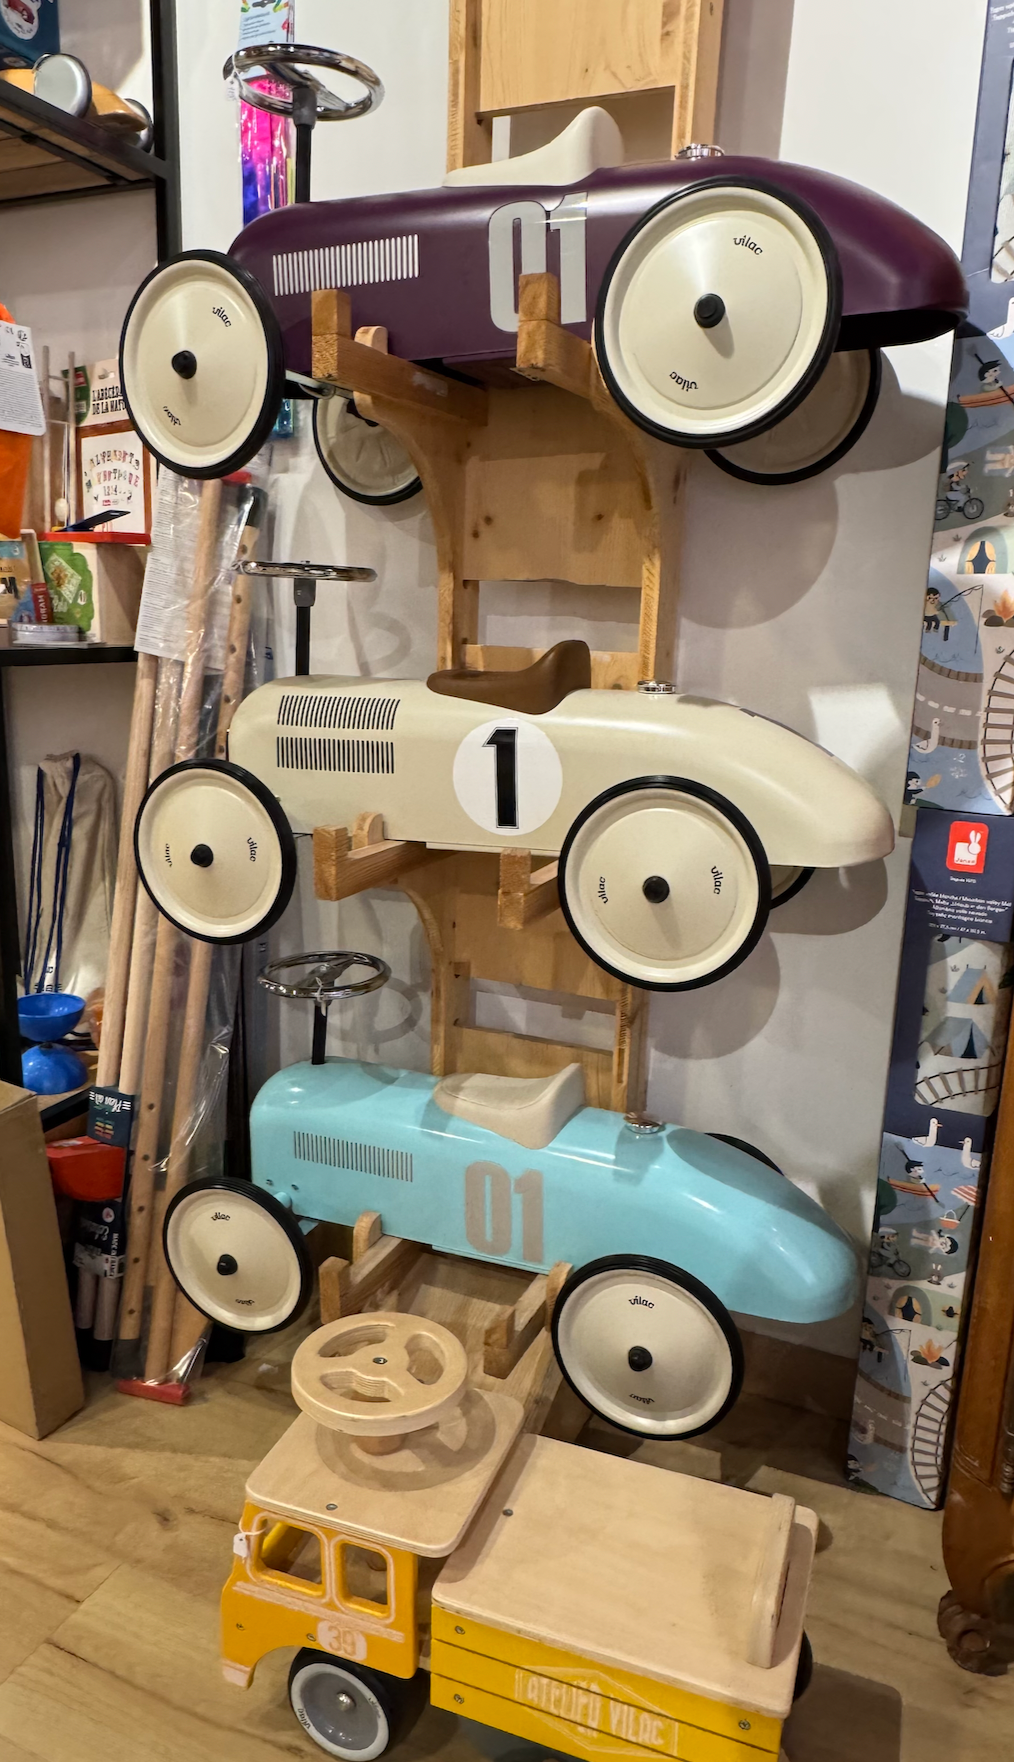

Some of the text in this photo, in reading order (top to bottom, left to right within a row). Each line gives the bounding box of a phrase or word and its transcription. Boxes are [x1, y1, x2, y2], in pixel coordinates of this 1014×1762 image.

[732, 233, 763, 256] vilac
[488, 191, 588, 332] 01
[211, 306, 232, 328] vilac
[668, 370, 699, 393] vilac
[481, 726, 519, 829] 1
[246, 836, 259, 863] vilac
[597, 875, 609, 904] vilac
[710, 865, 721, 896] vilac
[210, 1211, 231, 1221] vilac
[464, 1159, 545, 1264] 01
[628, 1294, 656, 1310] vilac
[609, 1695, 665, 1746] VILAC
